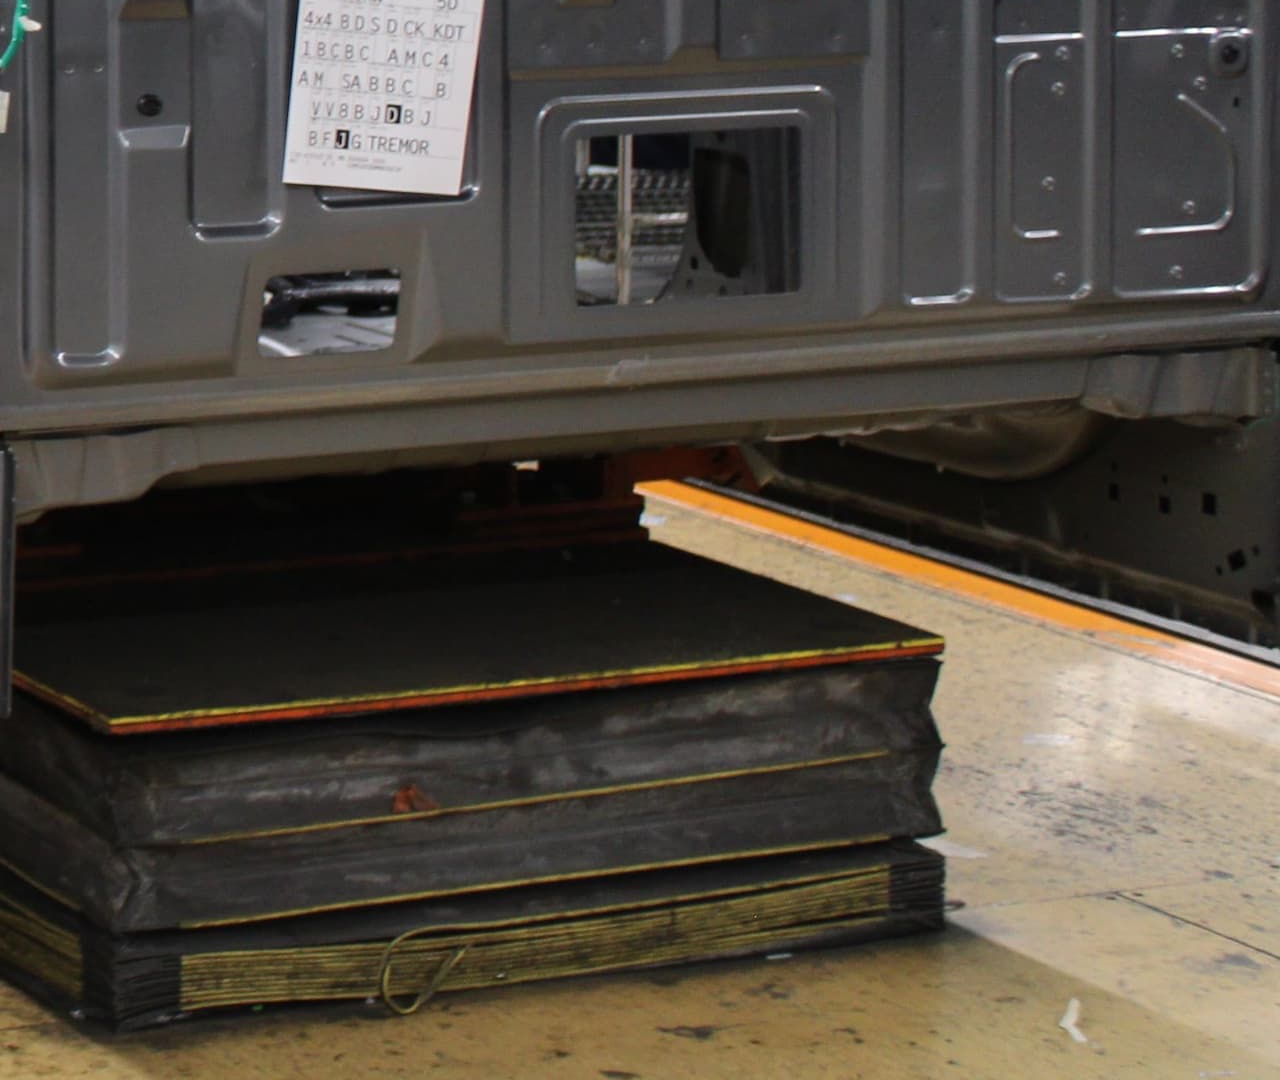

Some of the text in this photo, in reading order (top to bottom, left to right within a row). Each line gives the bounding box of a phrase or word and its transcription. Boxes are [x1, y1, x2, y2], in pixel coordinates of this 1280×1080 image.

[304, 11, 332, 26] 4x4
[433, 23, 465, 40] KDT
[368, 135, 429, 155] TREMOR
